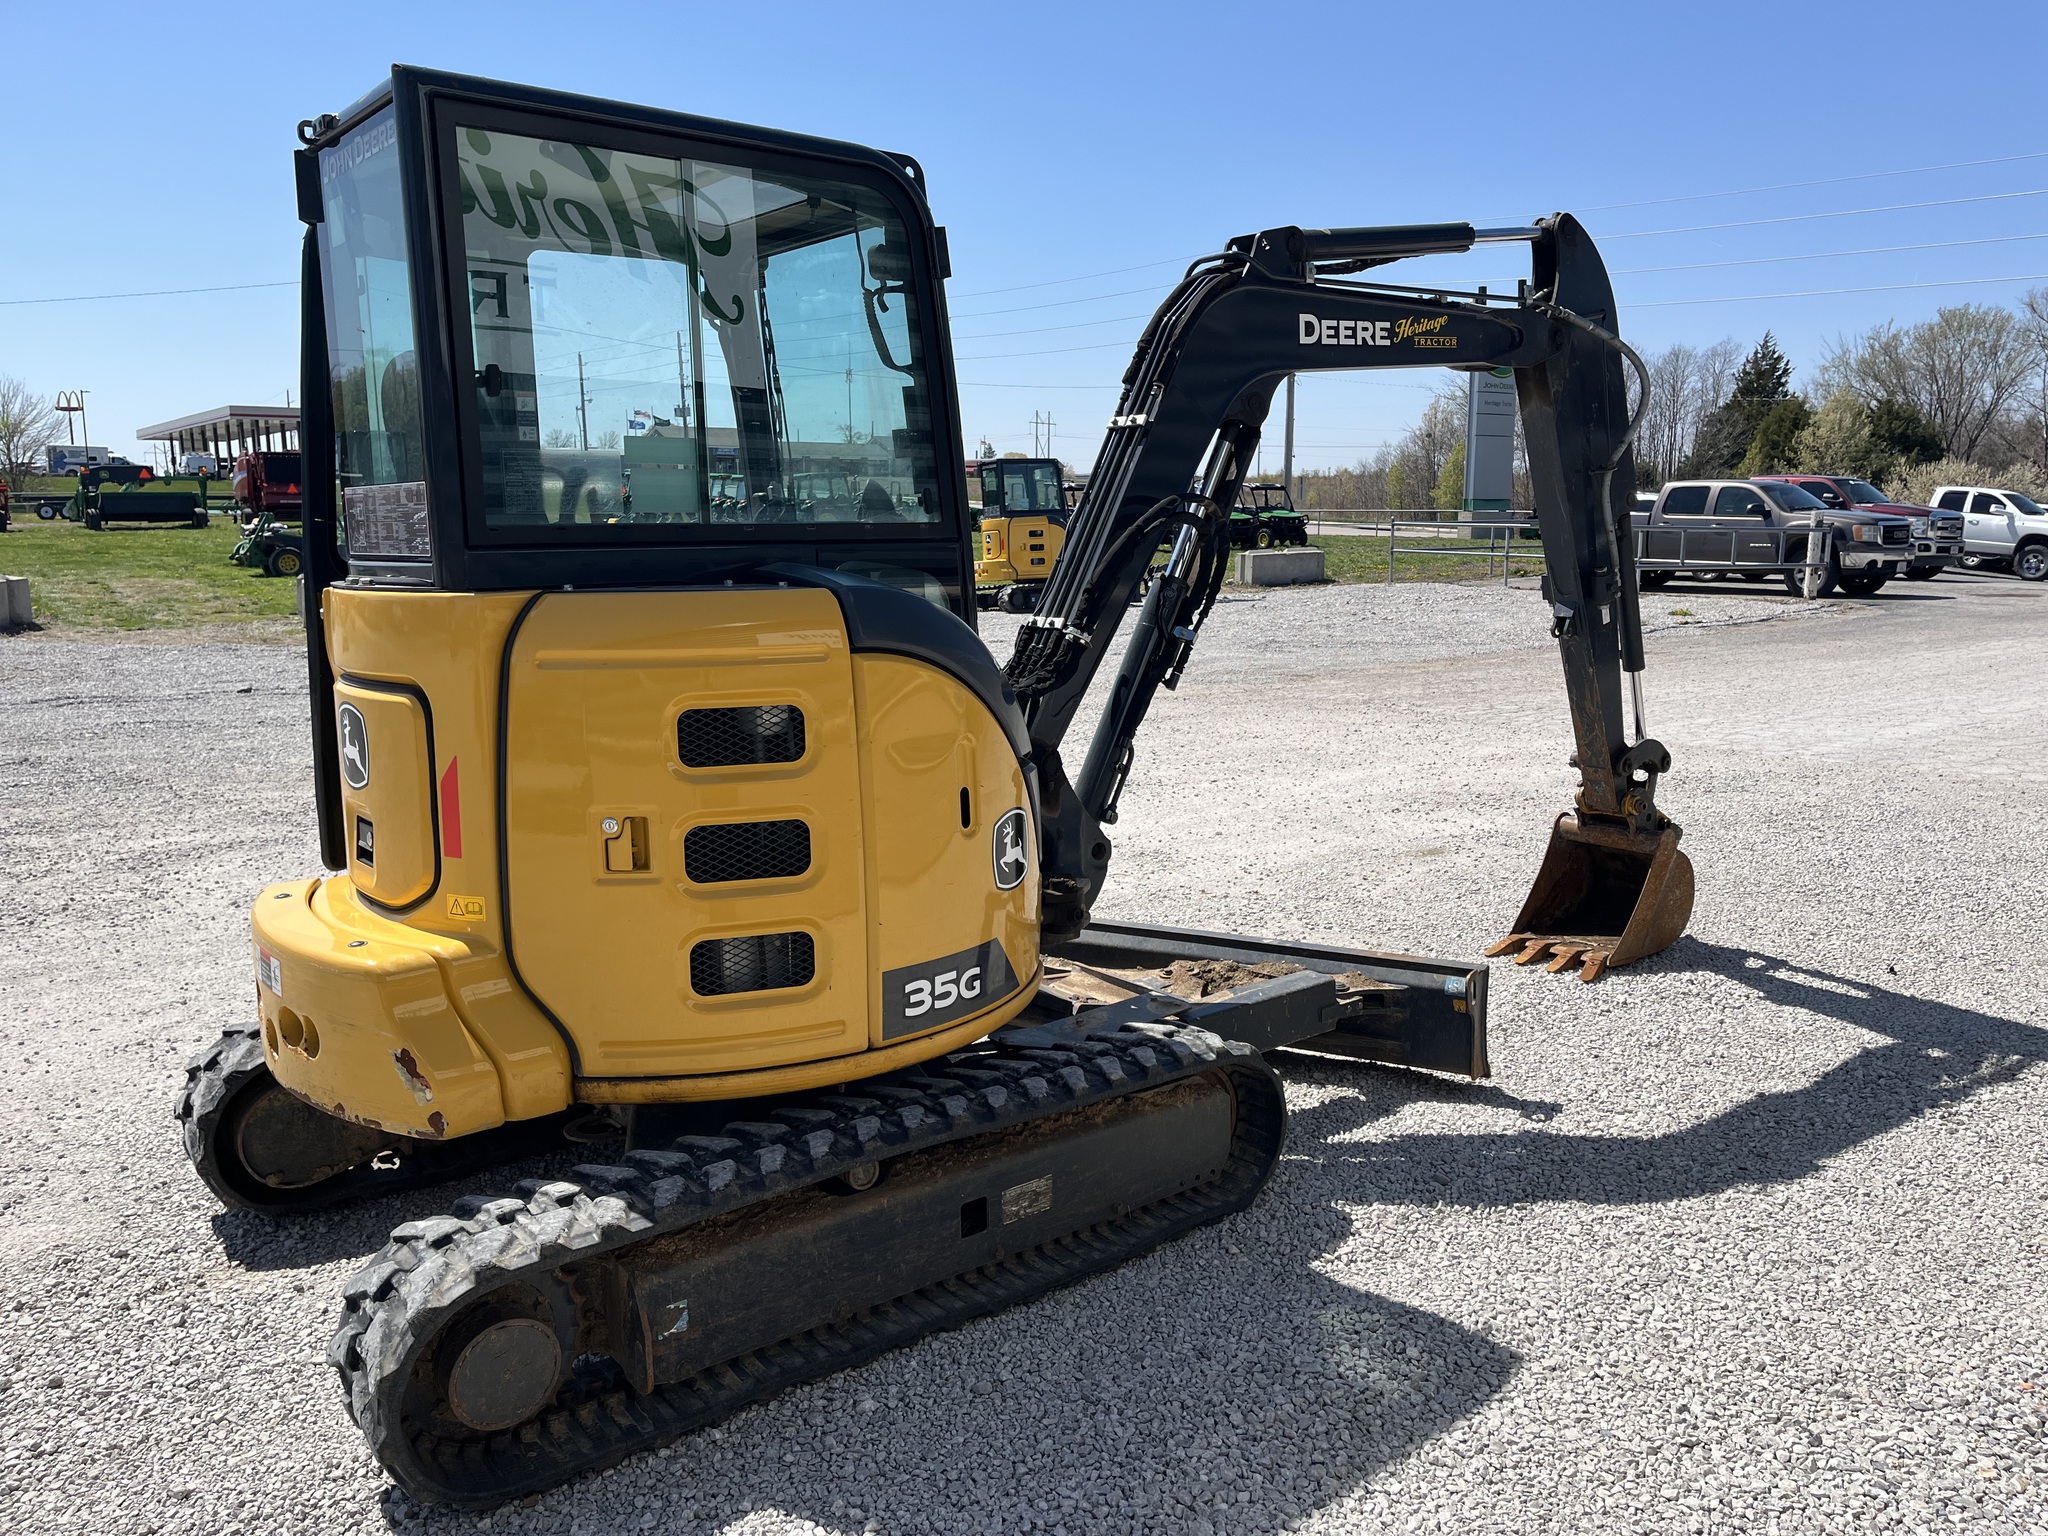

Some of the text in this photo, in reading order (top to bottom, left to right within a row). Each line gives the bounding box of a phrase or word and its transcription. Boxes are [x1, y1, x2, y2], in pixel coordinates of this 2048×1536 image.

[322, 118, 396, 184] JOHN DEERE
[1299, 313, 1391, 346] DEERE
[1393, 315, 1448, 343] Heritage
[1414, 338, 1457, 346] TRACTOR
[1483, 381, 1499, 389] JOHN
[904, 966, 981, 1017] 35G
